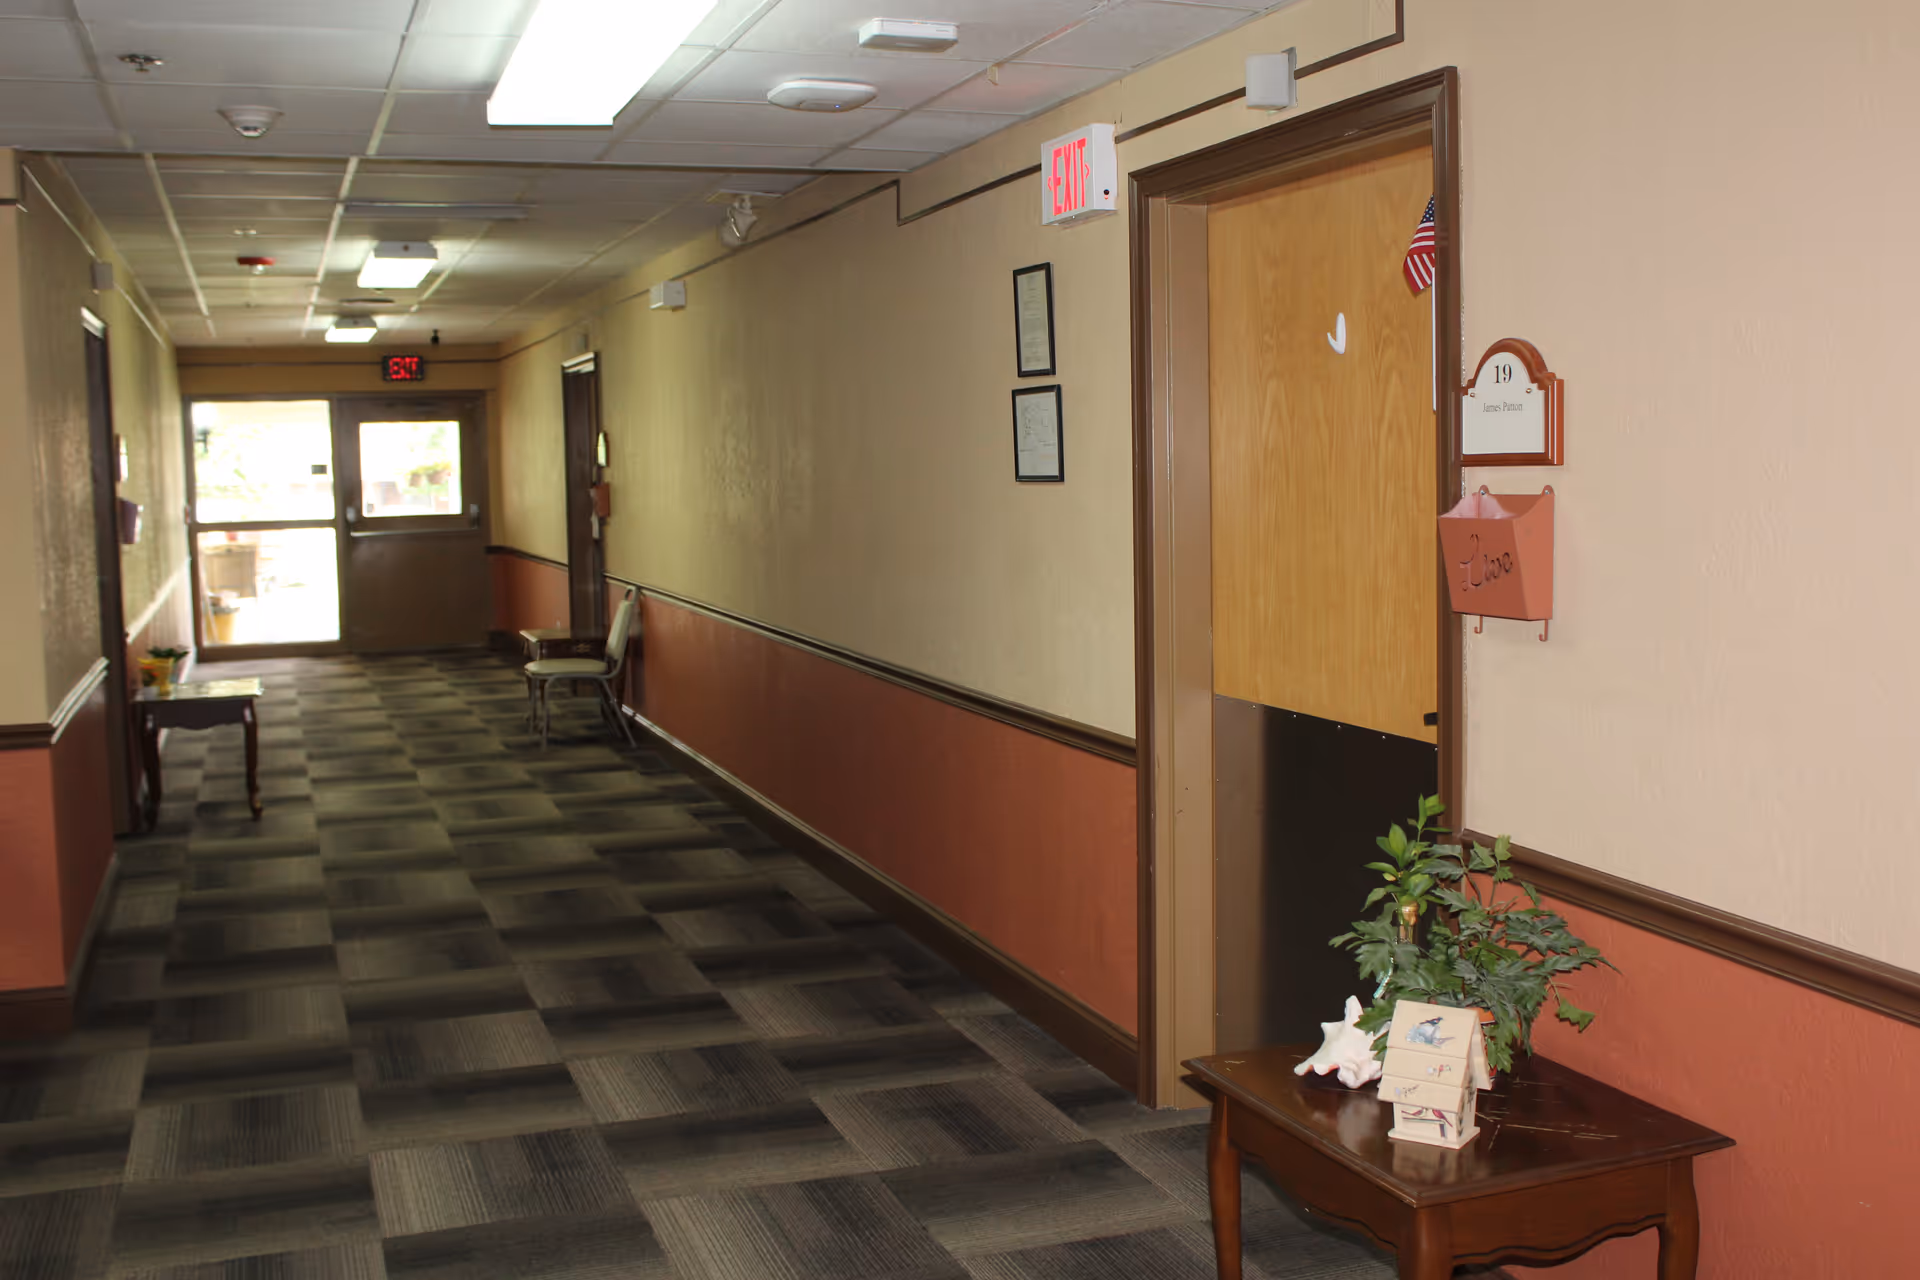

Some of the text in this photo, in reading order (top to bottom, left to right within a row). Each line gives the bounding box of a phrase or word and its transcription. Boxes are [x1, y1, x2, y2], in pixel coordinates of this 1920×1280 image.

[1051, 137, 1087, 217] EXIT
[388, 356, 419, 379] EXIT
[1494, 363, 1513, 384] 19
[1482, 402, 1501, 413] James
